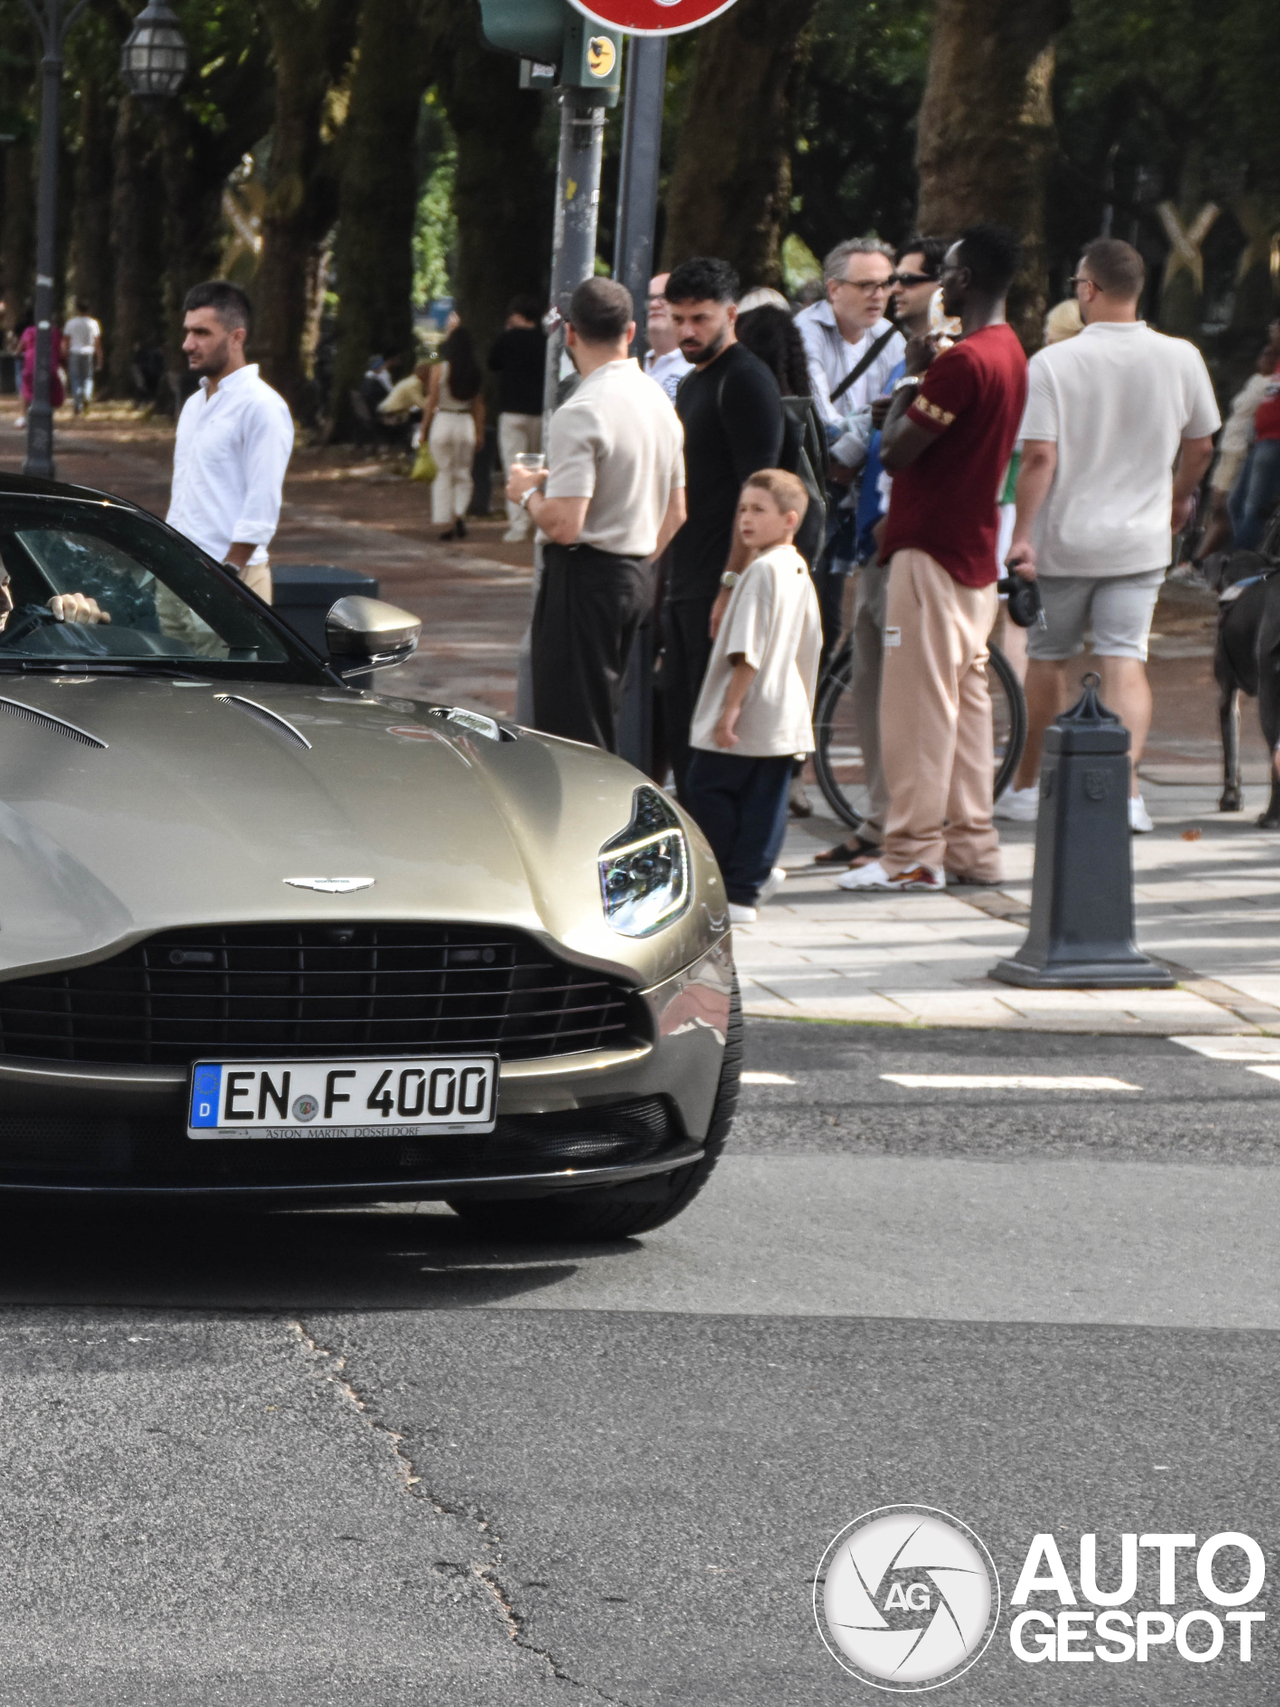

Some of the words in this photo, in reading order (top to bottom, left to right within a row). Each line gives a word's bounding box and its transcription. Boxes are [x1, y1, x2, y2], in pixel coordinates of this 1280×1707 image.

[224, 1071, 290, 1120] EN
[324, 1069, 356, 1118] F
[367, 1066, 487, 1117] 4000
[199, 1103, 210, 1117] D
[266, 1129, 303, 1139] ASTON
[307, 1128, 348, 1139] MARTIN
[354, 1126, 421, 1138] DÜSSELDORF
